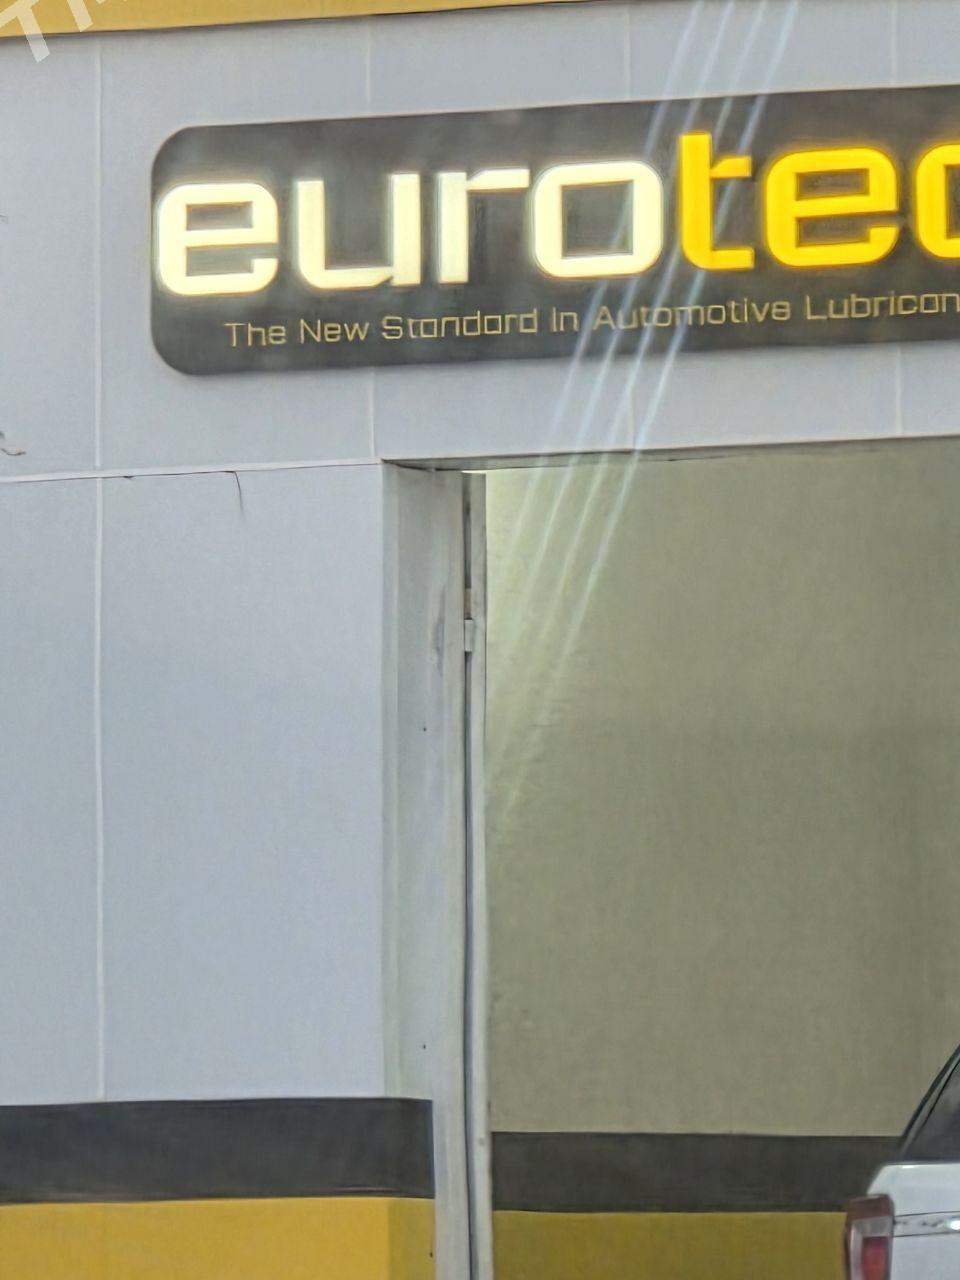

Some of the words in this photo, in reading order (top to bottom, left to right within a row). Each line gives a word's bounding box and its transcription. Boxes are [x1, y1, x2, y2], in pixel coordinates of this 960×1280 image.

[225, 322, 287, 347] The
[299, 316, 370, 344] New
[381, 307, 538, 341] Standard
[551, 306, 579, 333] In
[592, 297, 791, 332] Automotive
